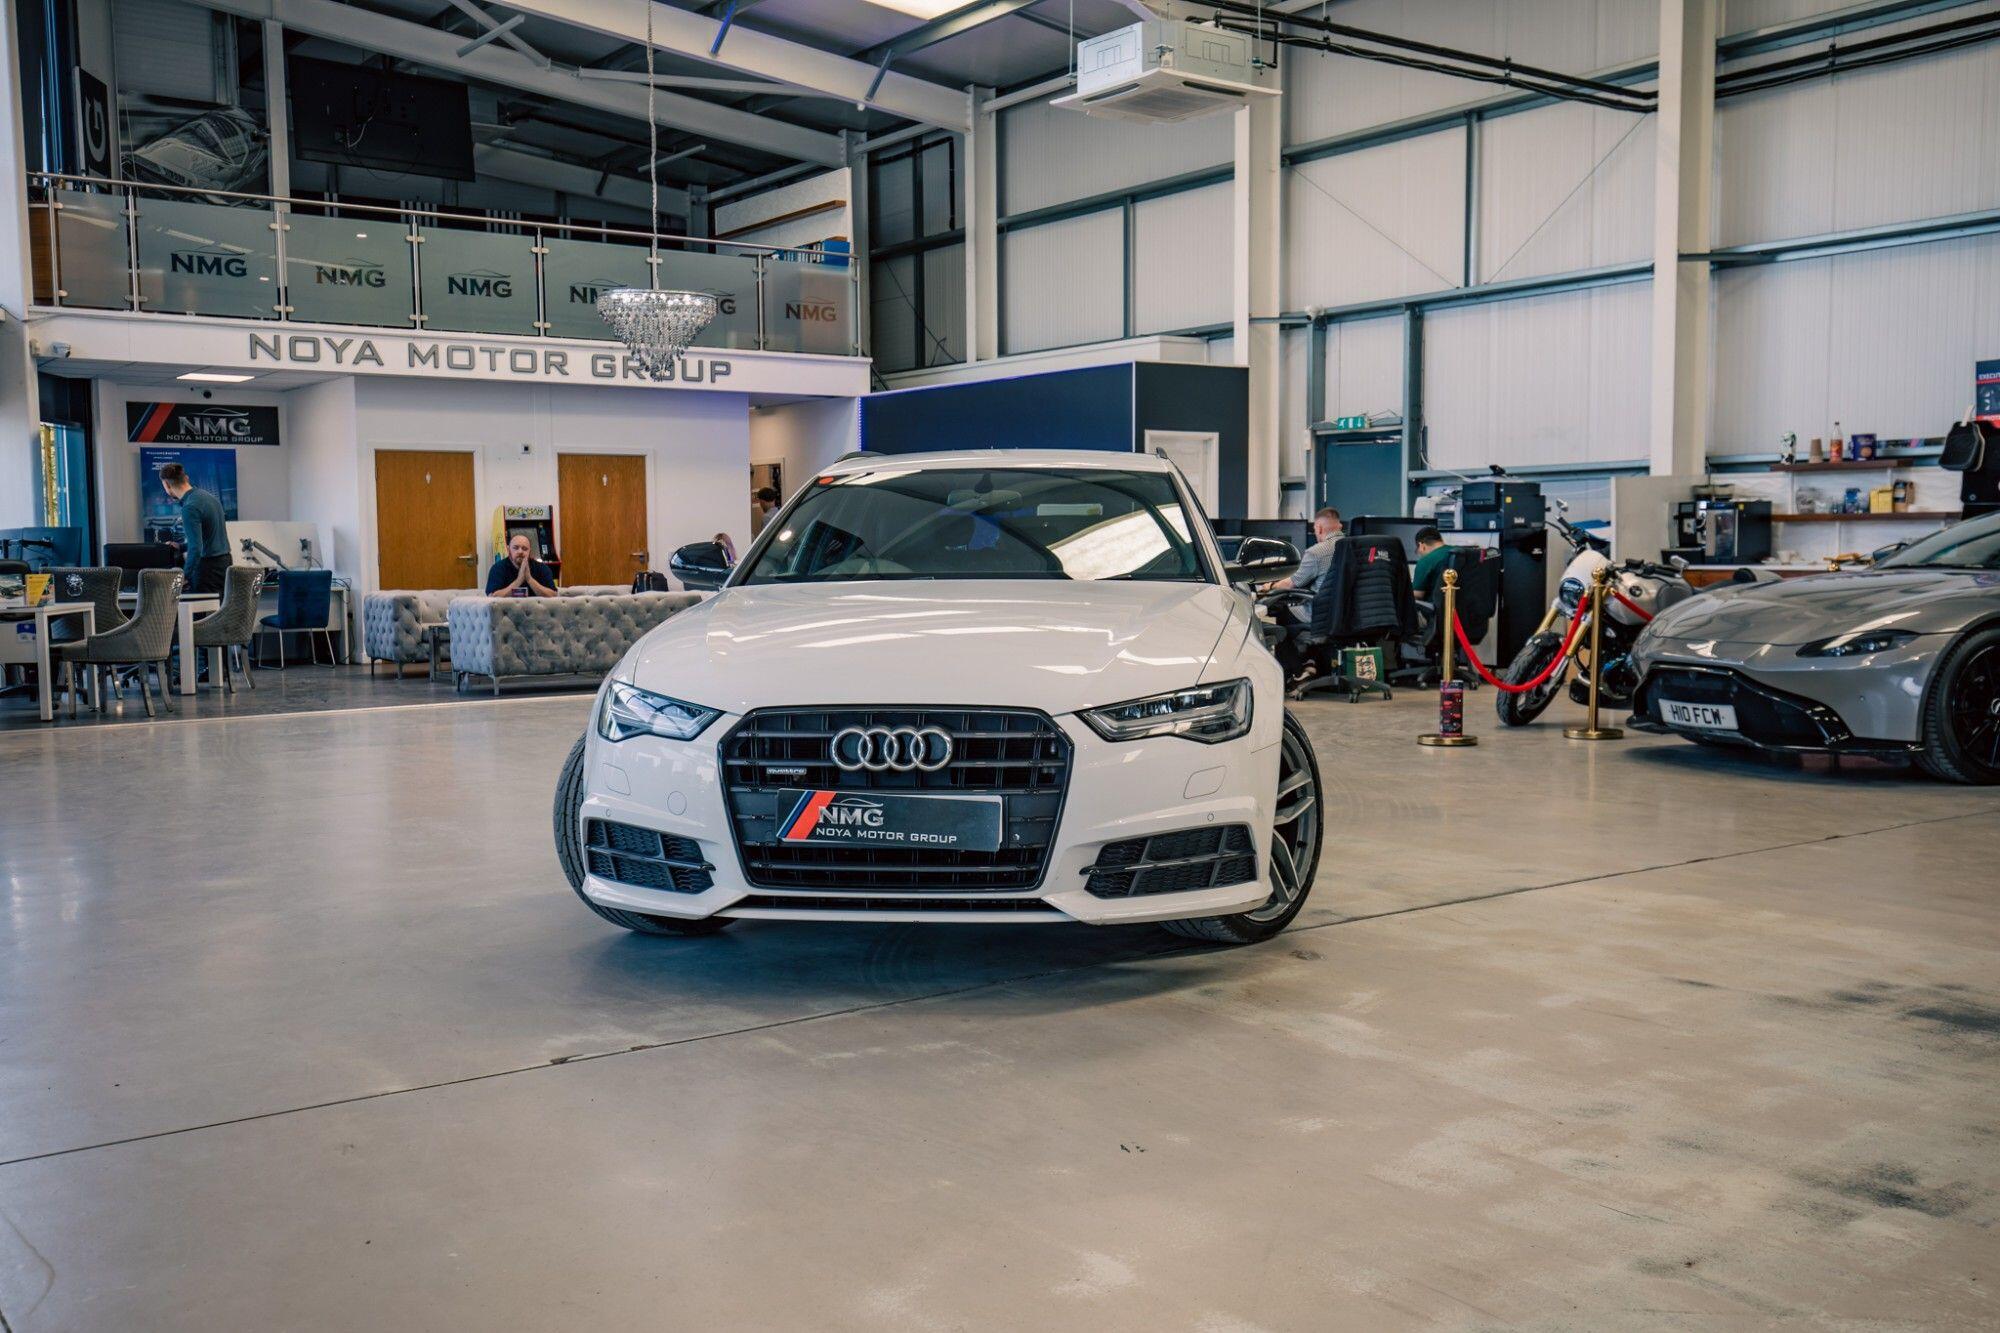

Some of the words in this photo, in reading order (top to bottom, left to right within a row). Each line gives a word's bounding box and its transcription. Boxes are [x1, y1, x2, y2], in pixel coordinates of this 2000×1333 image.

[170, 252, 247, 278] NMG
[315, 265, 386, 288] NMG
[448, 276, 513, 298] NMG
[785, 302, 837, 322] NMG
[249, 333, 384, 367] NOYA
[408, 342, 569, 375] MOTOR
[178, 416, 251, 436] NMG
[1692, 707, 1722, 725] FCW
[817, 805, 885, 827] NMG
[815, 827, 851, 838] NOYA
[857, 829, 905, 841] MOTOR
[910, 833, 958, 844] GROUP
